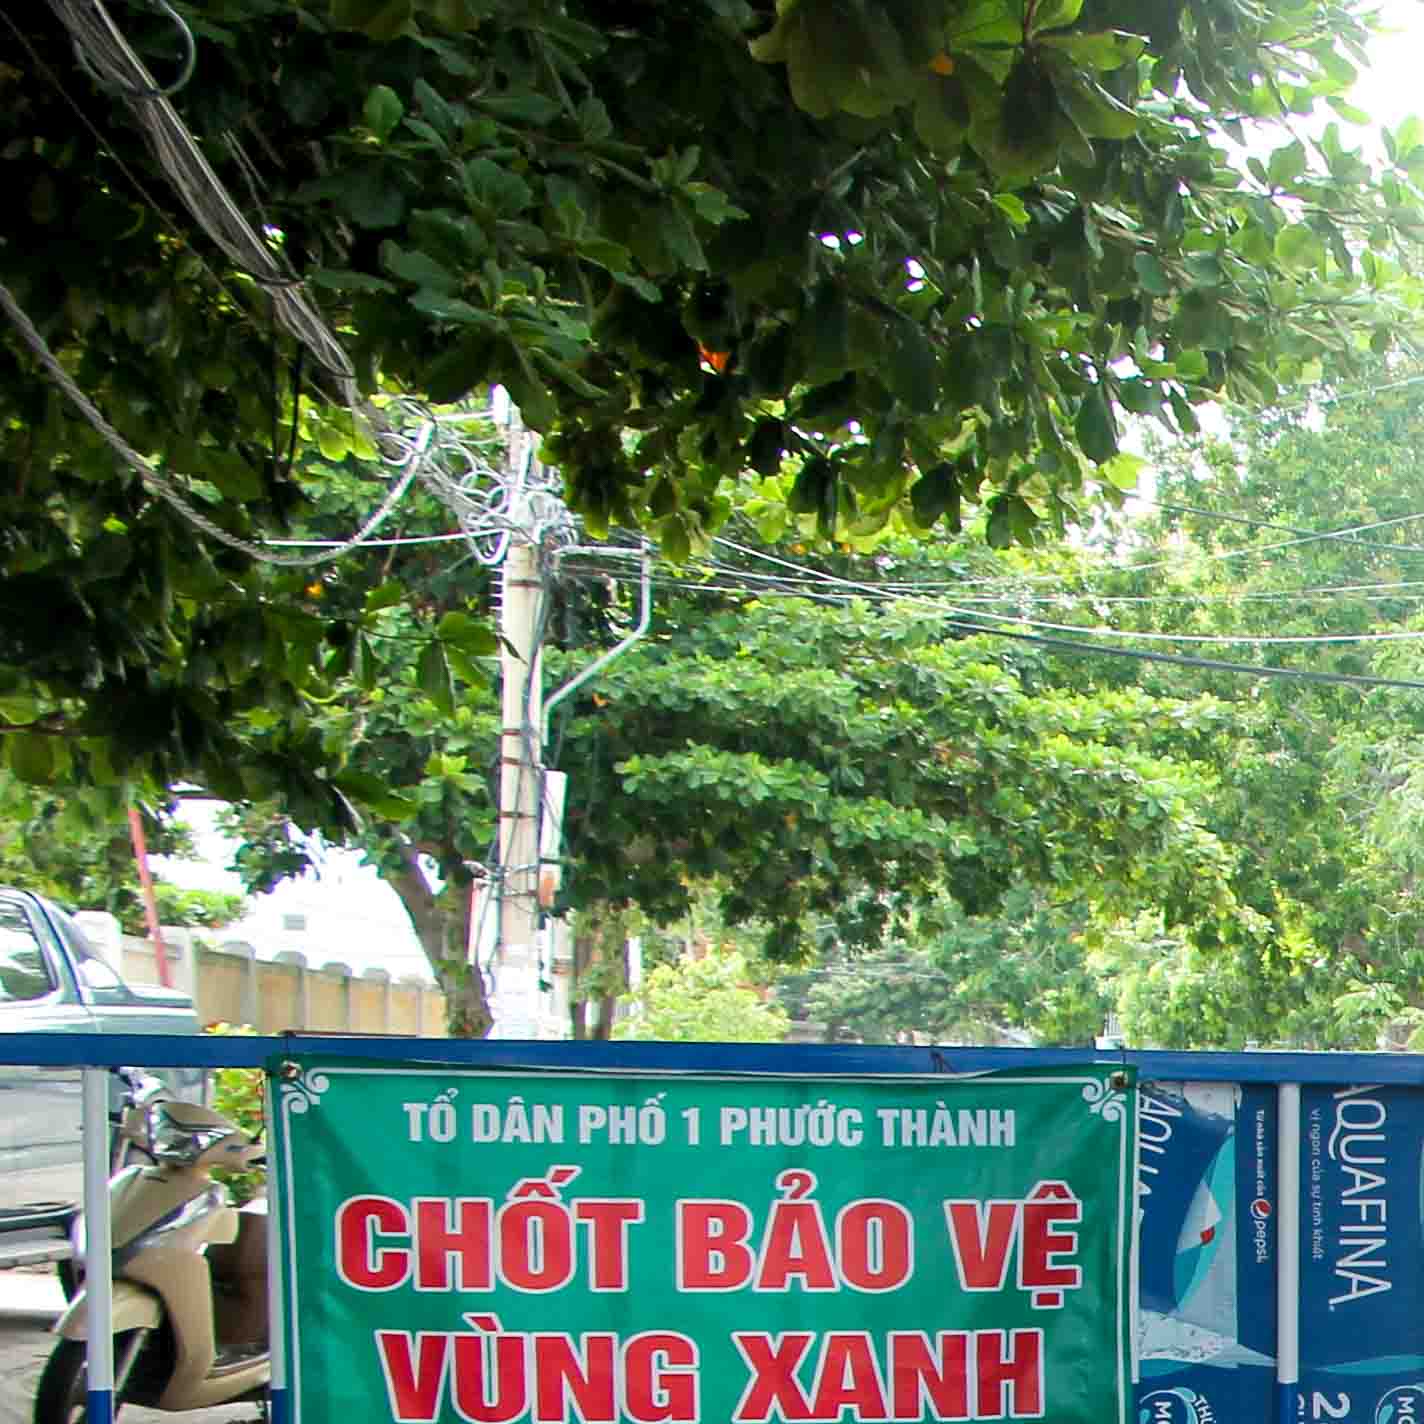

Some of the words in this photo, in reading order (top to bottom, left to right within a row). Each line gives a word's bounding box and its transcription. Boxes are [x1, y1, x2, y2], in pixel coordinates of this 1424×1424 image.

[403, 1087, 458, 1142] TỔ
[472, 1096, 563, 1143] DÂN
[579, 1093, 666, 1145] PHỐ
[682, 1107, 699, 1145] 1
[720, 1099, 863, 1147] PHƯỚC
[877, 1101, 1015, 1146] THÀNH
[334, 1164, 645, 1294] CHỐT
[675, 1168, 915, 1294] BẢO
[943, 1180, 1083, 1310] VỆ
[730, 1327, 1045, 1424] XANH
